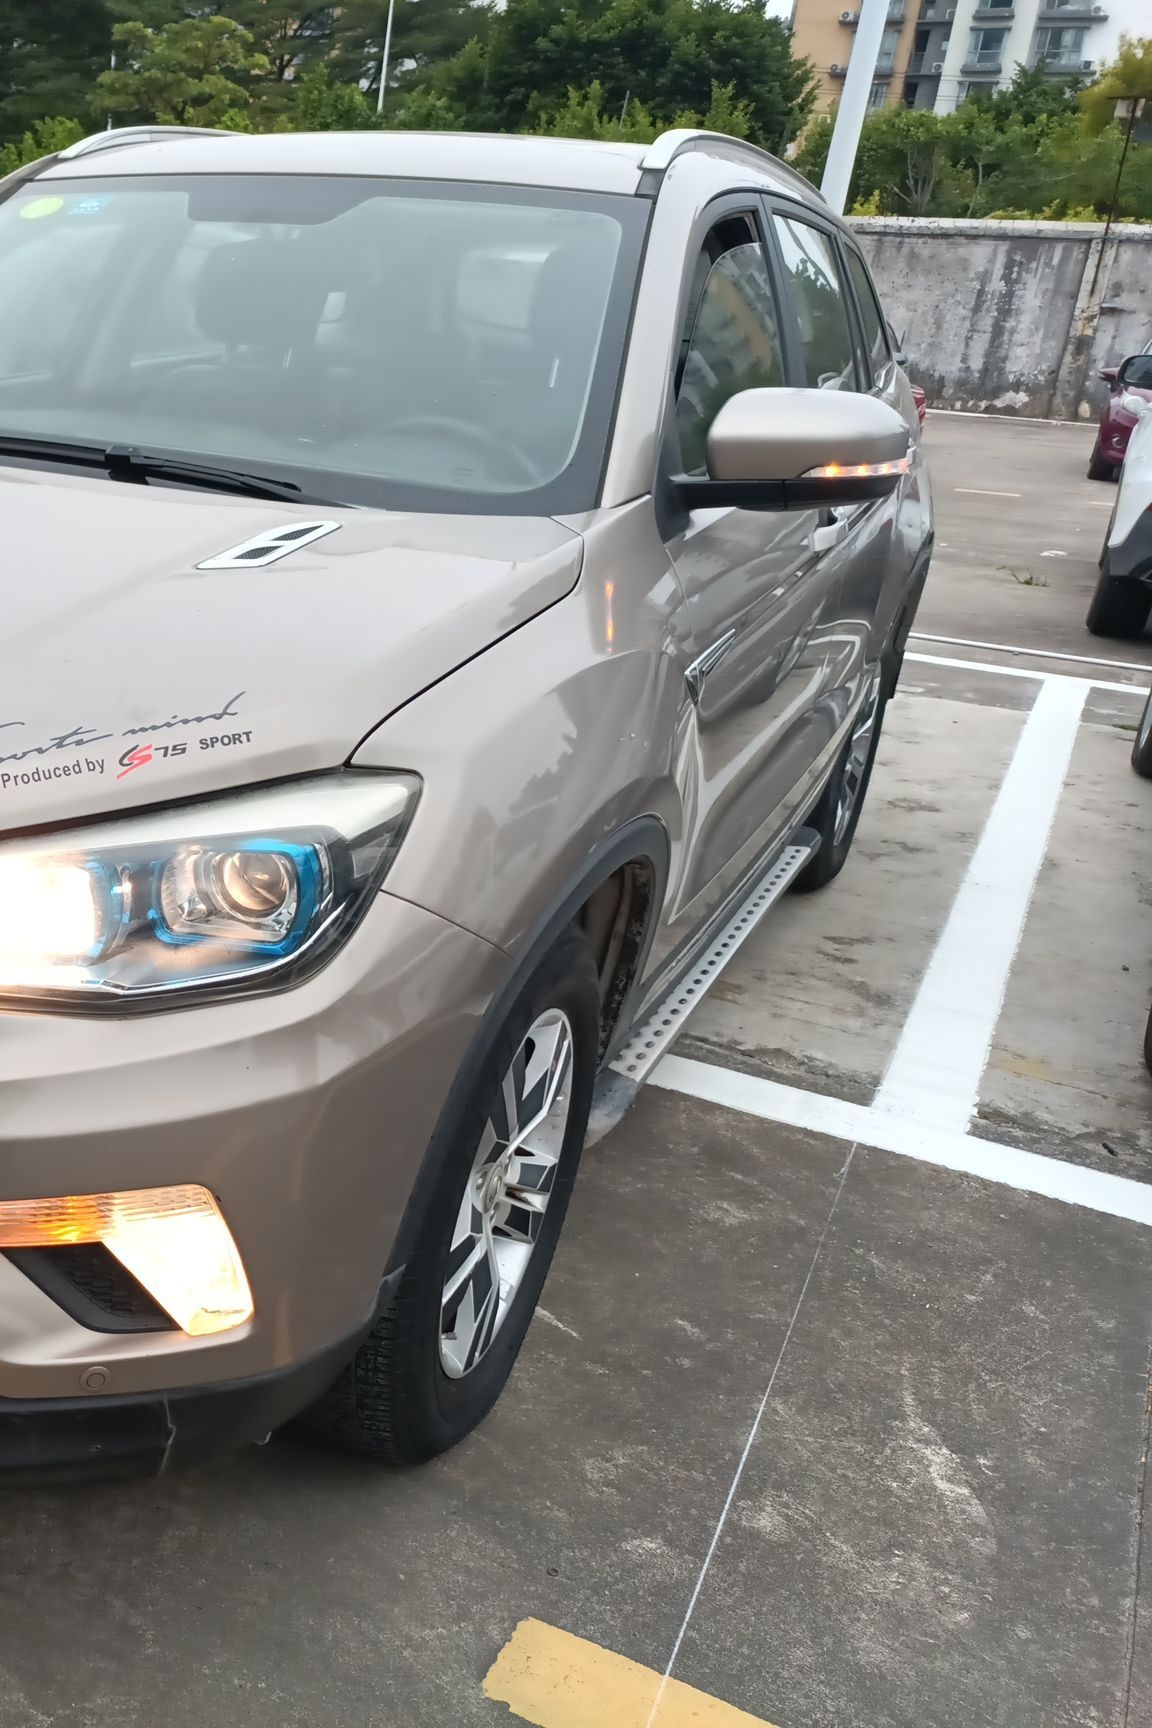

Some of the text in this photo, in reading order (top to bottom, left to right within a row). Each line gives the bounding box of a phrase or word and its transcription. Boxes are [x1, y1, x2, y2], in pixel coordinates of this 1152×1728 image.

[0, 762, 83, 789] Produced
[85, 756, 106, 774] by
[199, 730, 253, 751] SPORT
